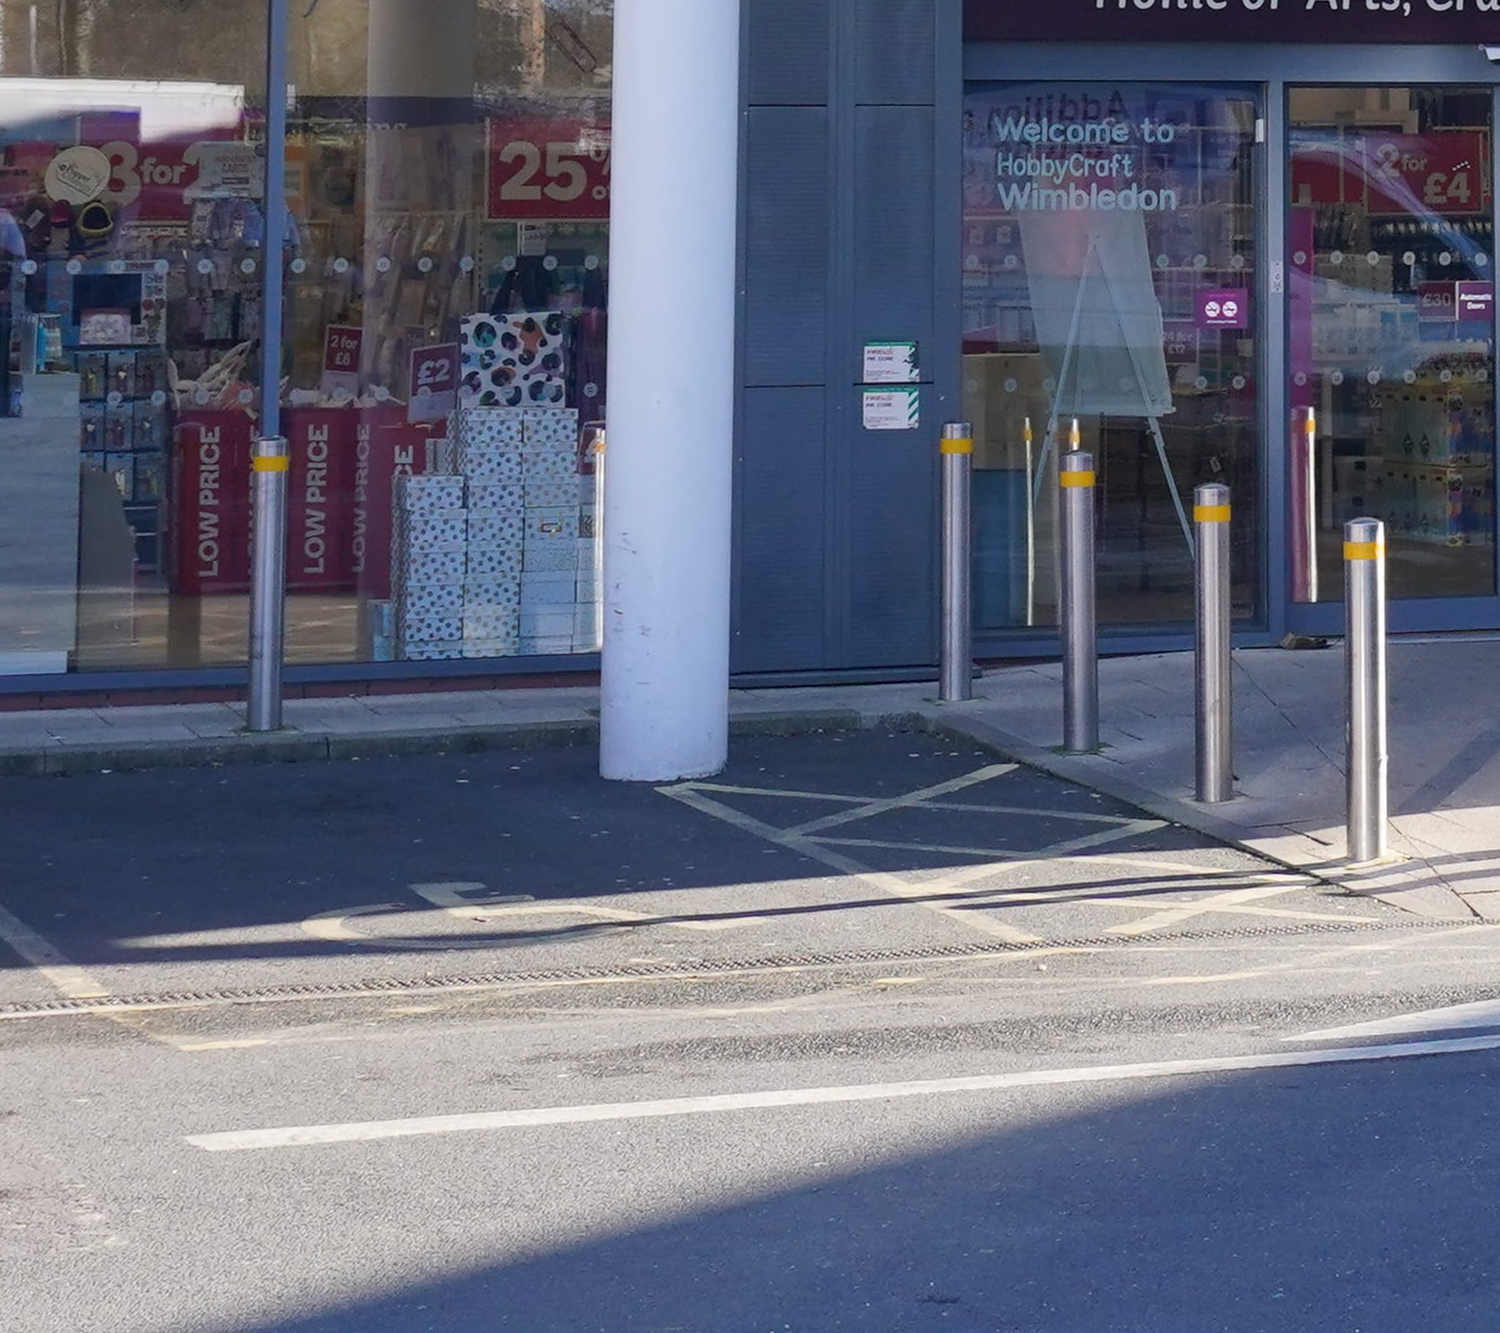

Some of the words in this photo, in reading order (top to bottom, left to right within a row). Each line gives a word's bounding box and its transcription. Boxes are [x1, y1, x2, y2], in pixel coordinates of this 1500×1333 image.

[995, 117, 1130, 144] Welcome
[1142, 120, 1175, 143] to
[100, 140, 141, 206] 3
[141, 156, 187, 185] for
[997, 152, 1134, 183] HobbyCraft
[1374, 143, 1401, 180] 2
[1402, 154, 1427, 173] for
[997, 182, 1178, 212] Wimbledon
[1423, 172, 1471, 204] £4
[1460, 292, 1493, 301] Automatic
[1466, 301, 1486, 310] Doors
[330, 335, 339, 348] 2
[340, 336, 358, 350] for
[417, 358, 451, 385] £2
[199, 425, 220, 506] PRICE
[304, 424, 328, 503] PRICE
[199, 509, 220, 577] LOW
[304, 507, 328, 574] LOW
